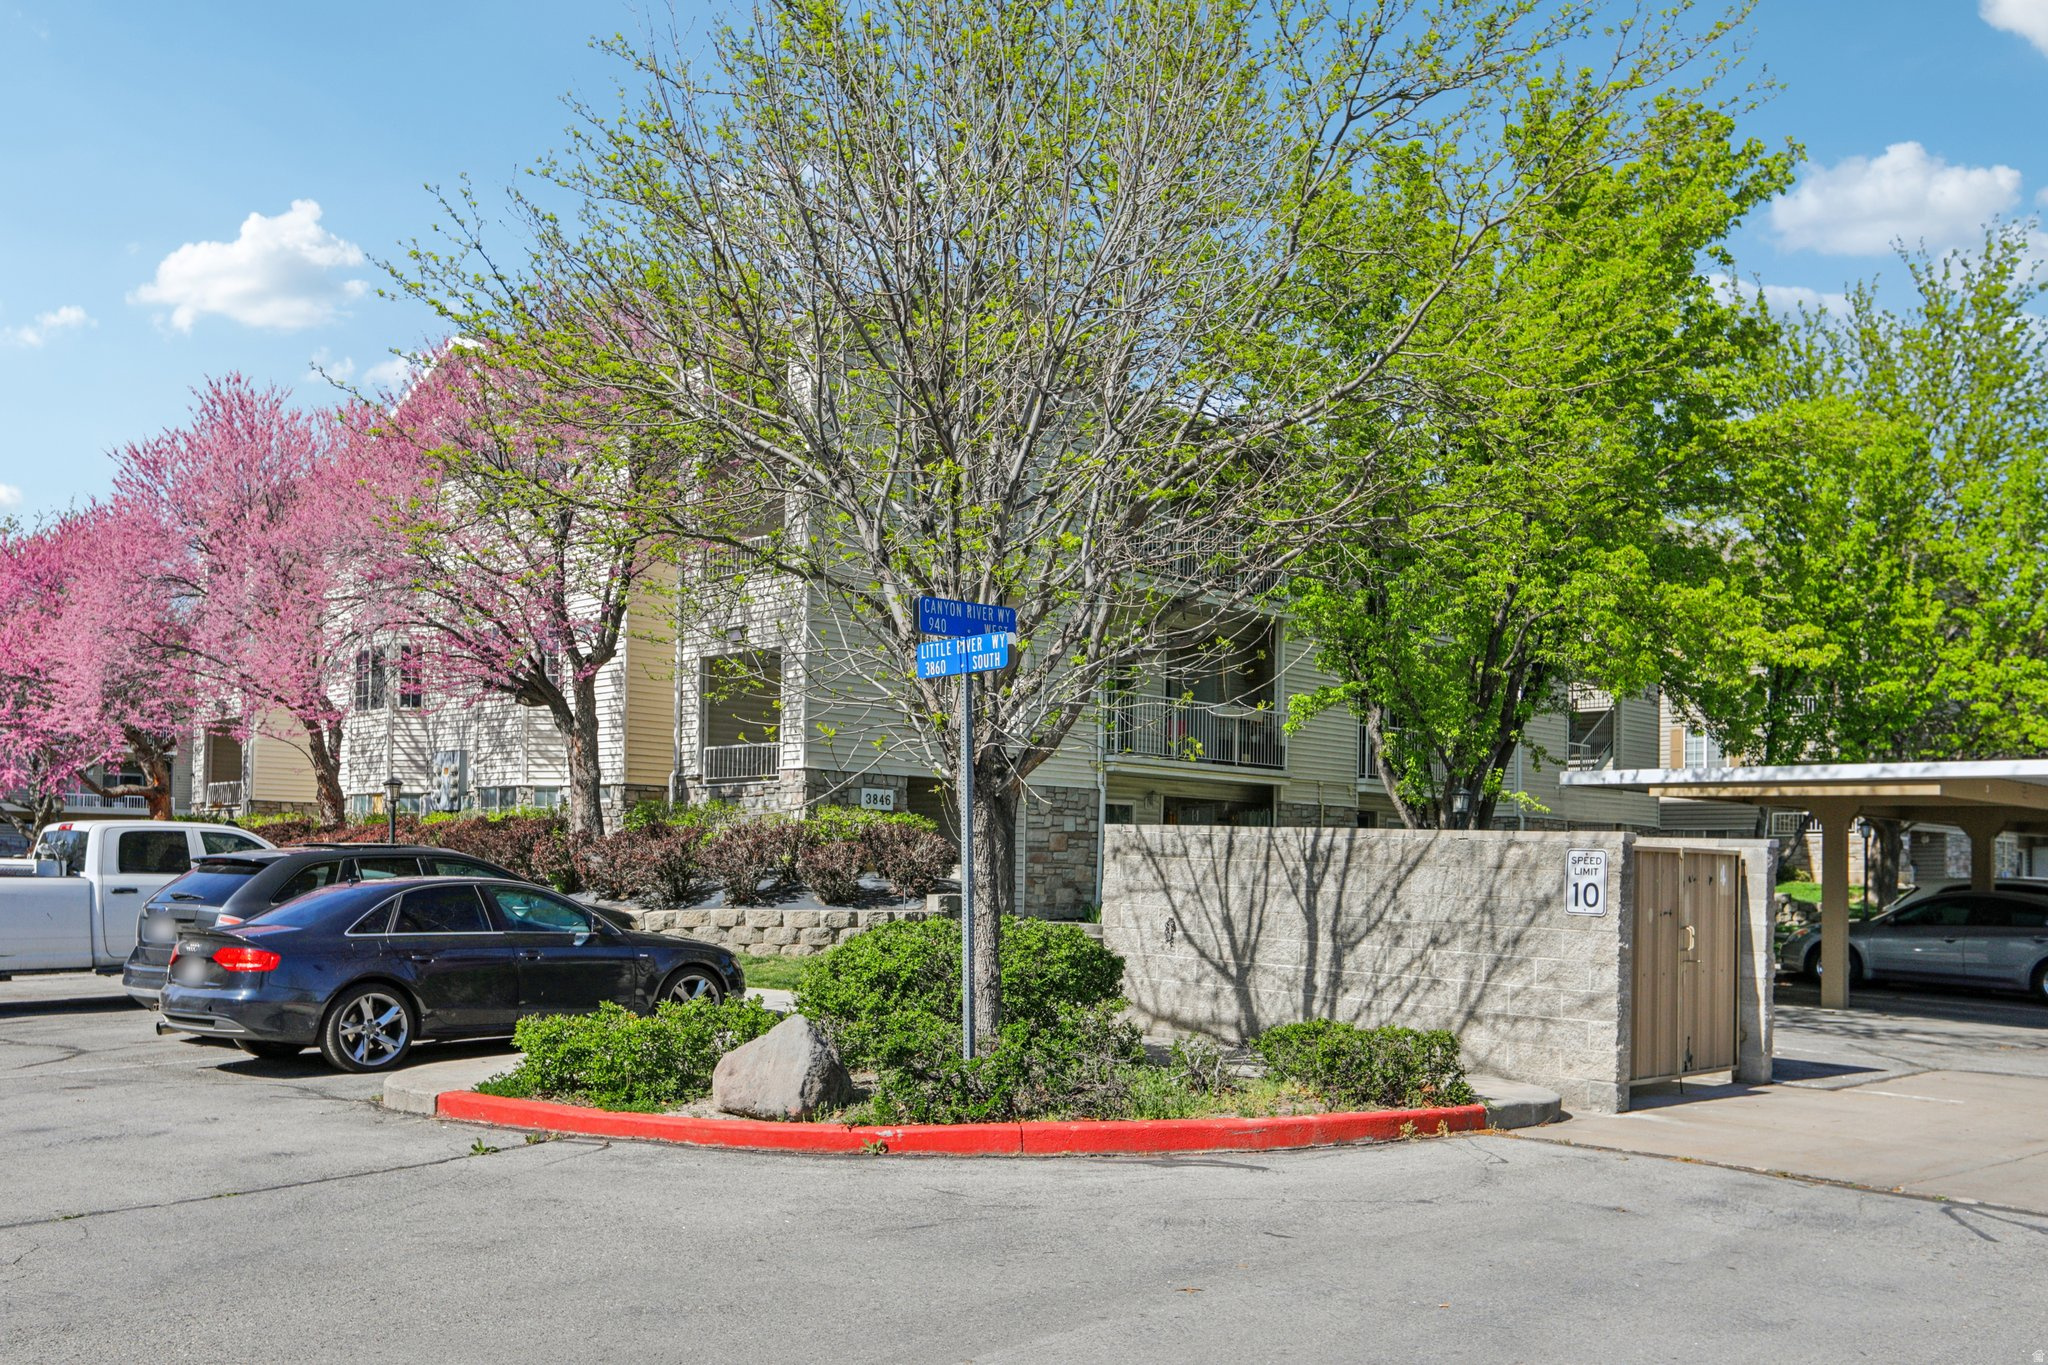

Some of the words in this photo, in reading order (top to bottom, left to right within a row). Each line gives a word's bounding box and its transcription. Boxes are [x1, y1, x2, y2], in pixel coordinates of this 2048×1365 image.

[924, 599, 962, 617] CANYON
[966, 605, 994, 622] RIVER
[997, 609, 1011, 623] WY
[929, 617, 947, 633] 940
[921, 641, 952, 659] LITTLE
[957, 637, 983, 655] RIVER
[991, 634, 1006, 649] WY
[925, 660, 946, 676] 3860
[972, 652, 1001, 670] SOUTH
[865, 793, 891, 806] 3846
[1571, 856, 1602, 865] SPEED
[1574, 868, 1599, 876] LIMIT
[1573, 882, 1599, 908] 10
